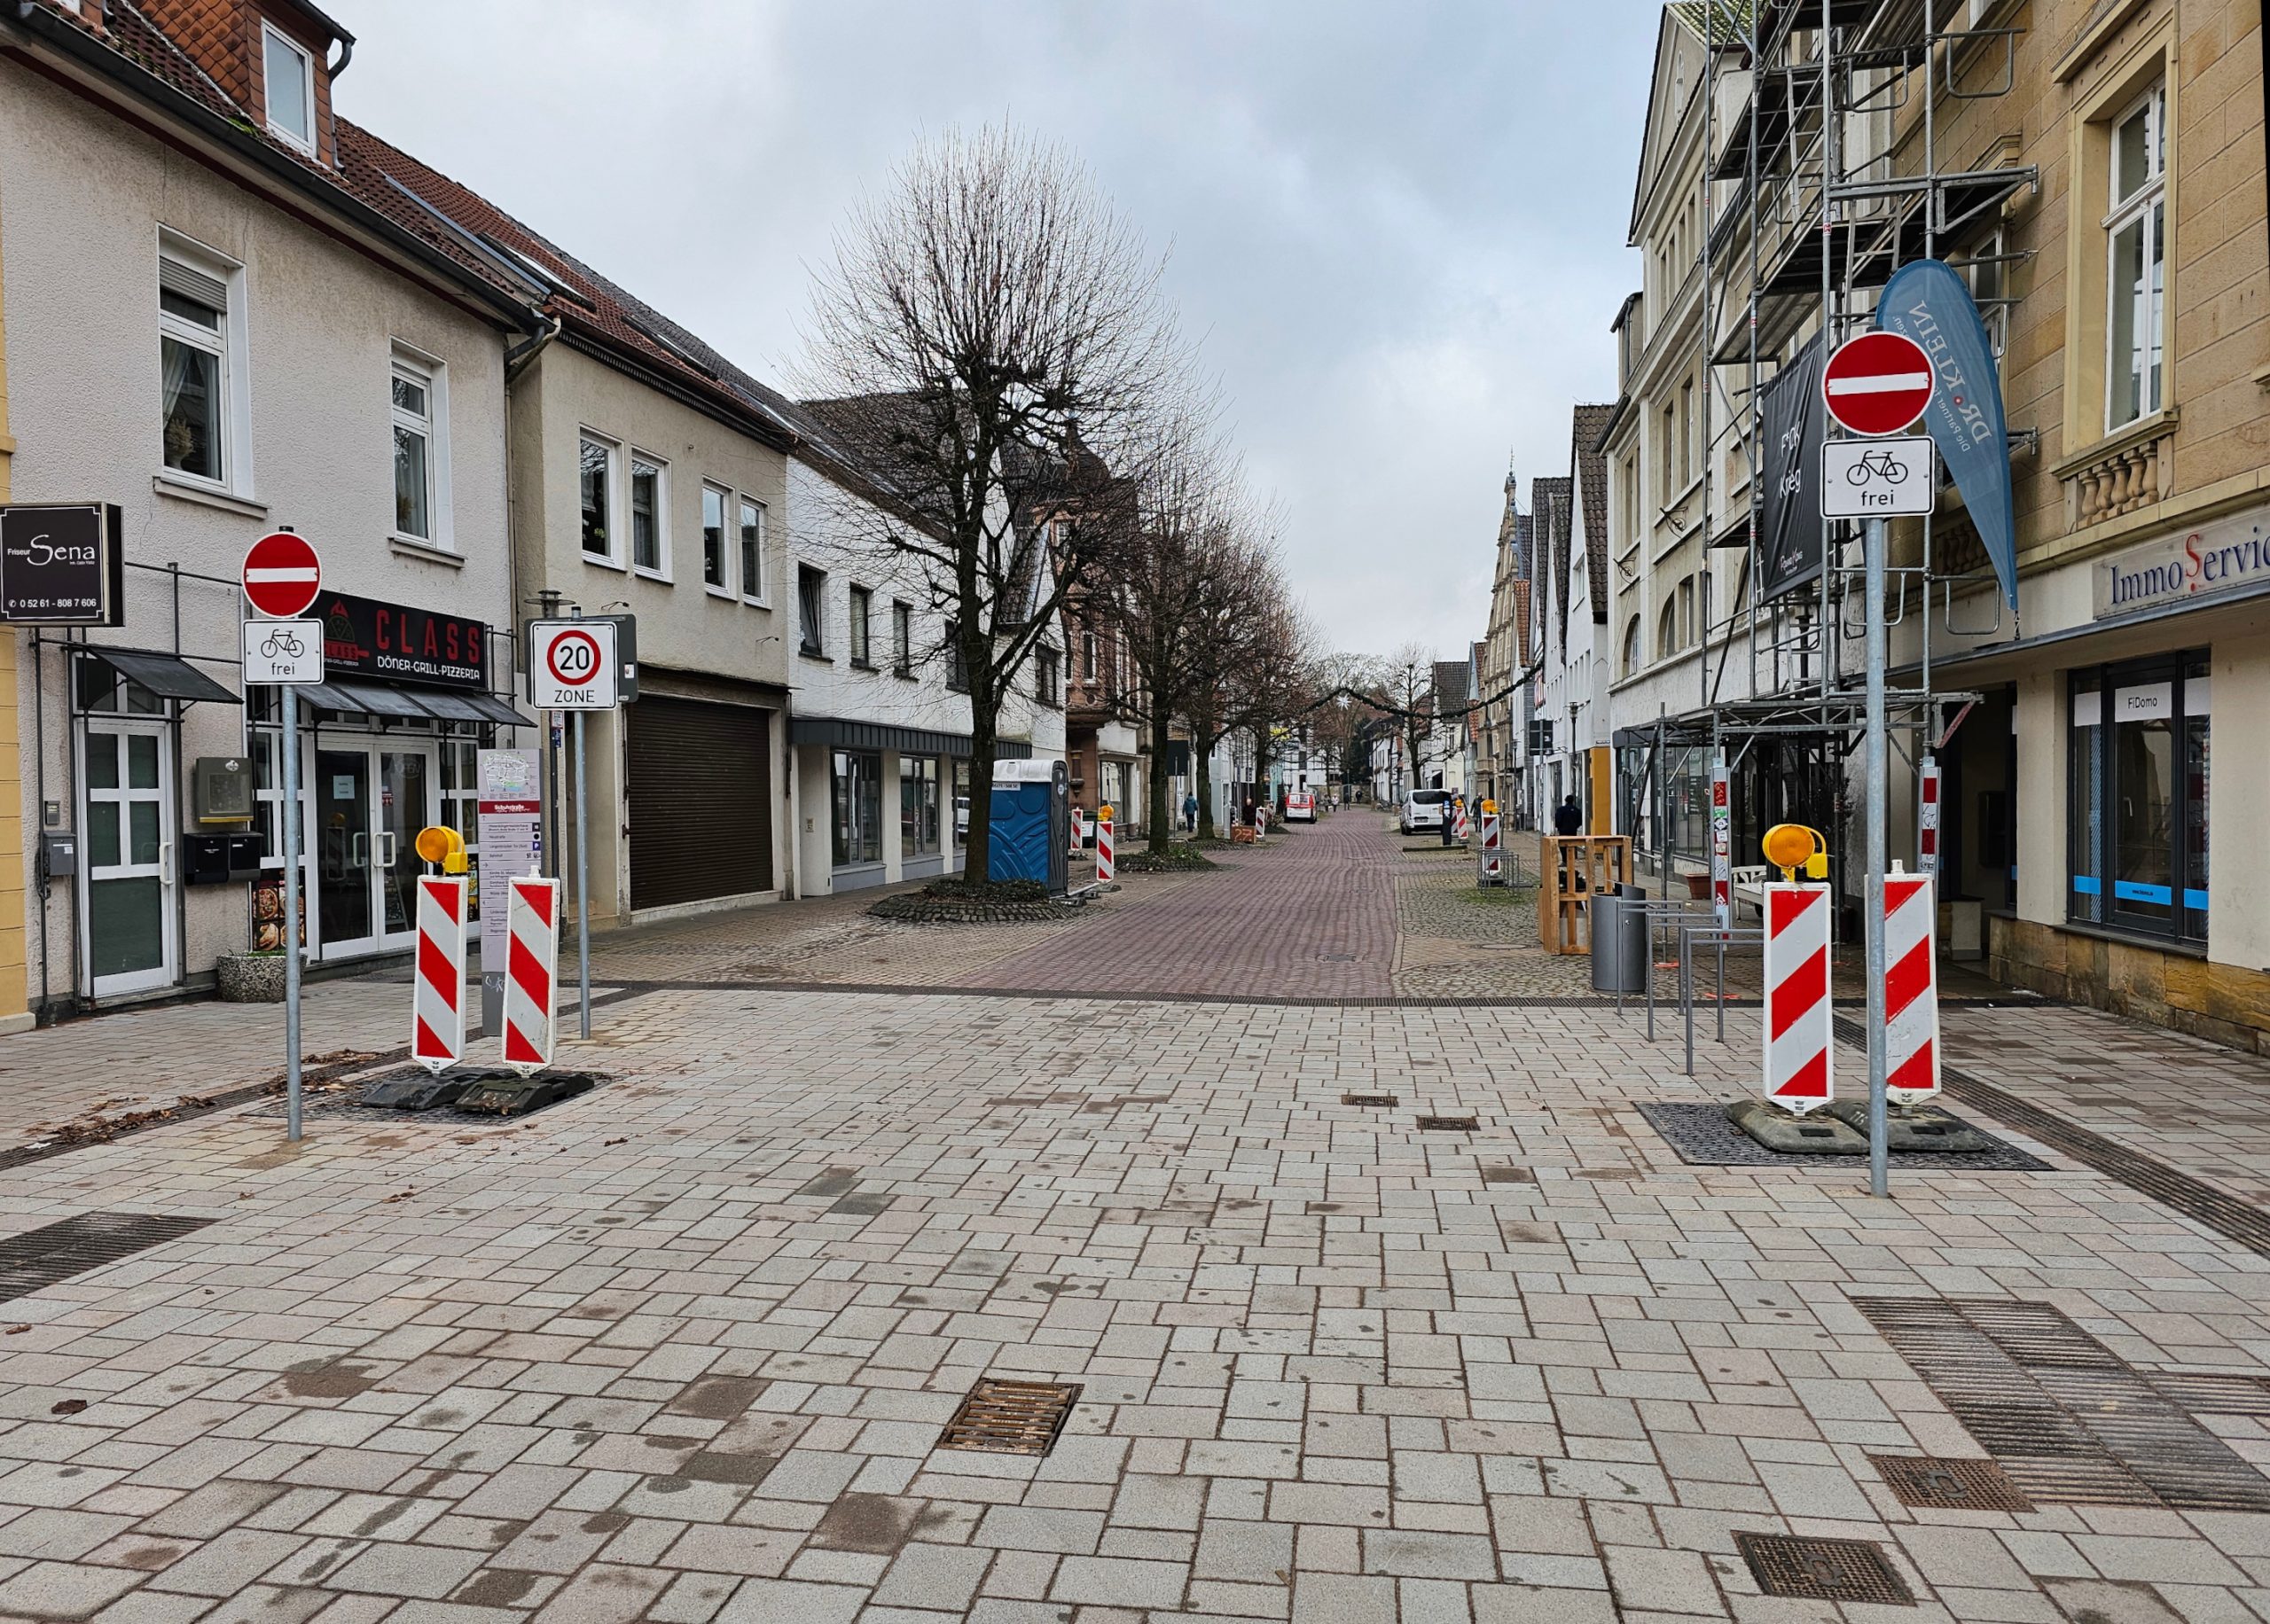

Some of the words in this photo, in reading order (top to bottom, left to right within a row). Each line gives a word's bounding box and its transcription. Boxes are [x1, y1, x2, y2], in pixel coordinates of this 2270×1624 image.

[1780, 468, 1801, 499] Krieg
[1861, 489, 1894, 506] frei
[27, 534, 96, 566] Sena
[20, 598, 26, 608] 0
[27, 598, 38, 608] 52
[40, 598, 50, 608] 61
[57, 598, 73, 608] 808
[74, 598, 80, 607] 7
[81, 598, 97, 607] 606
[376, 608, 481, 664] CLASS
[560, 645, 590, 670] 20
[271, 662, 295, 675] frei
[554, 690, 595, 703] ZONE
[2128, 697, 2157, 709] FiDomo
